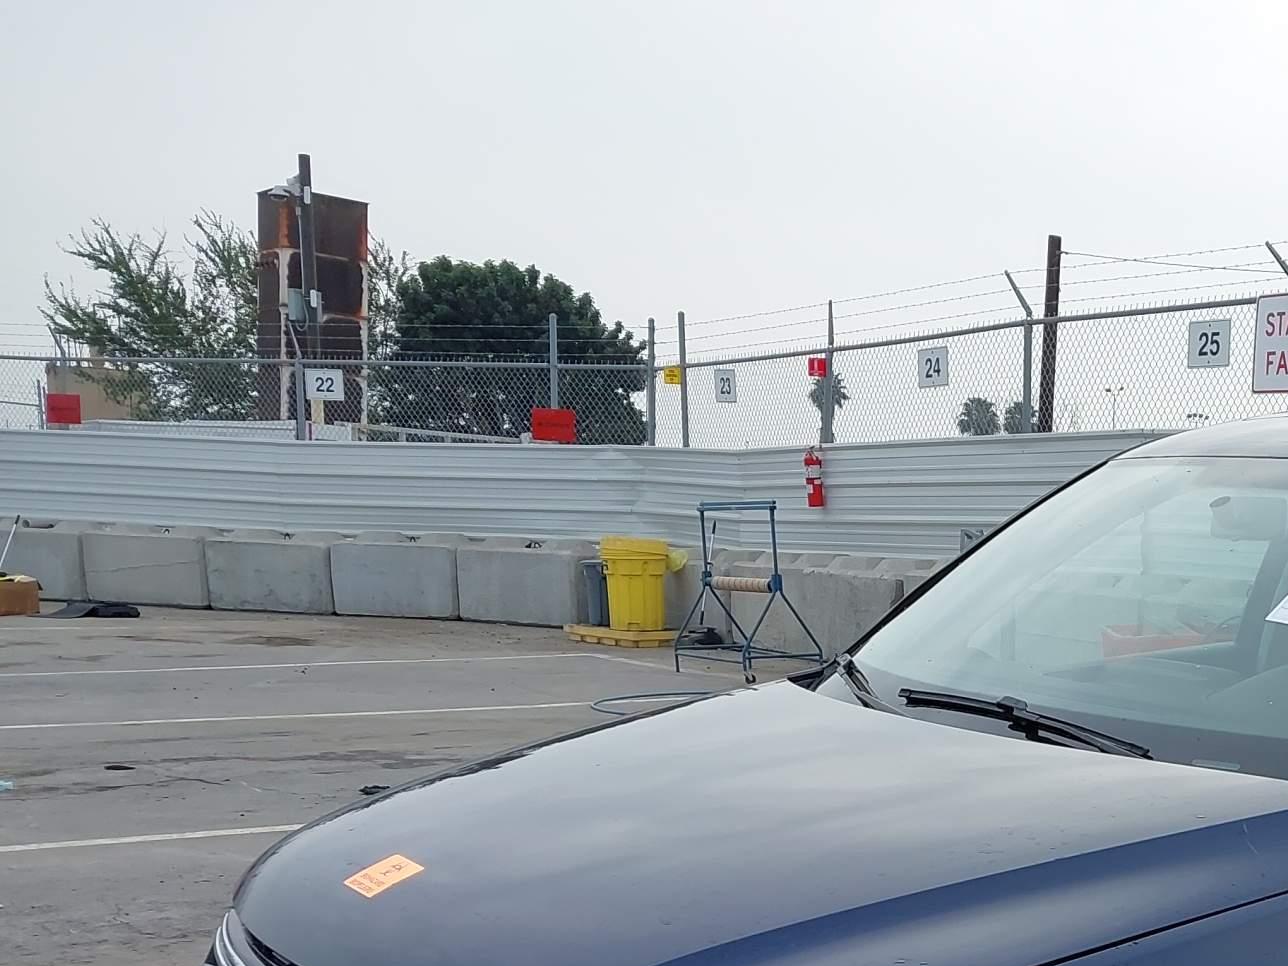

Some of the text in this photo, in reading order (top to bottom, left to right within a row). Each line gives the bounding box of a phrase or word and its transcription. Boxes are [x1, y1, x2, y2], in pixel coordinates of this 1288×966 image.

[1198, 331, 1220, 356] 25
[925, 357, 941, 378] 24
[315, 376, 335, 393] 22
[719, 377, 732, 395] 23
